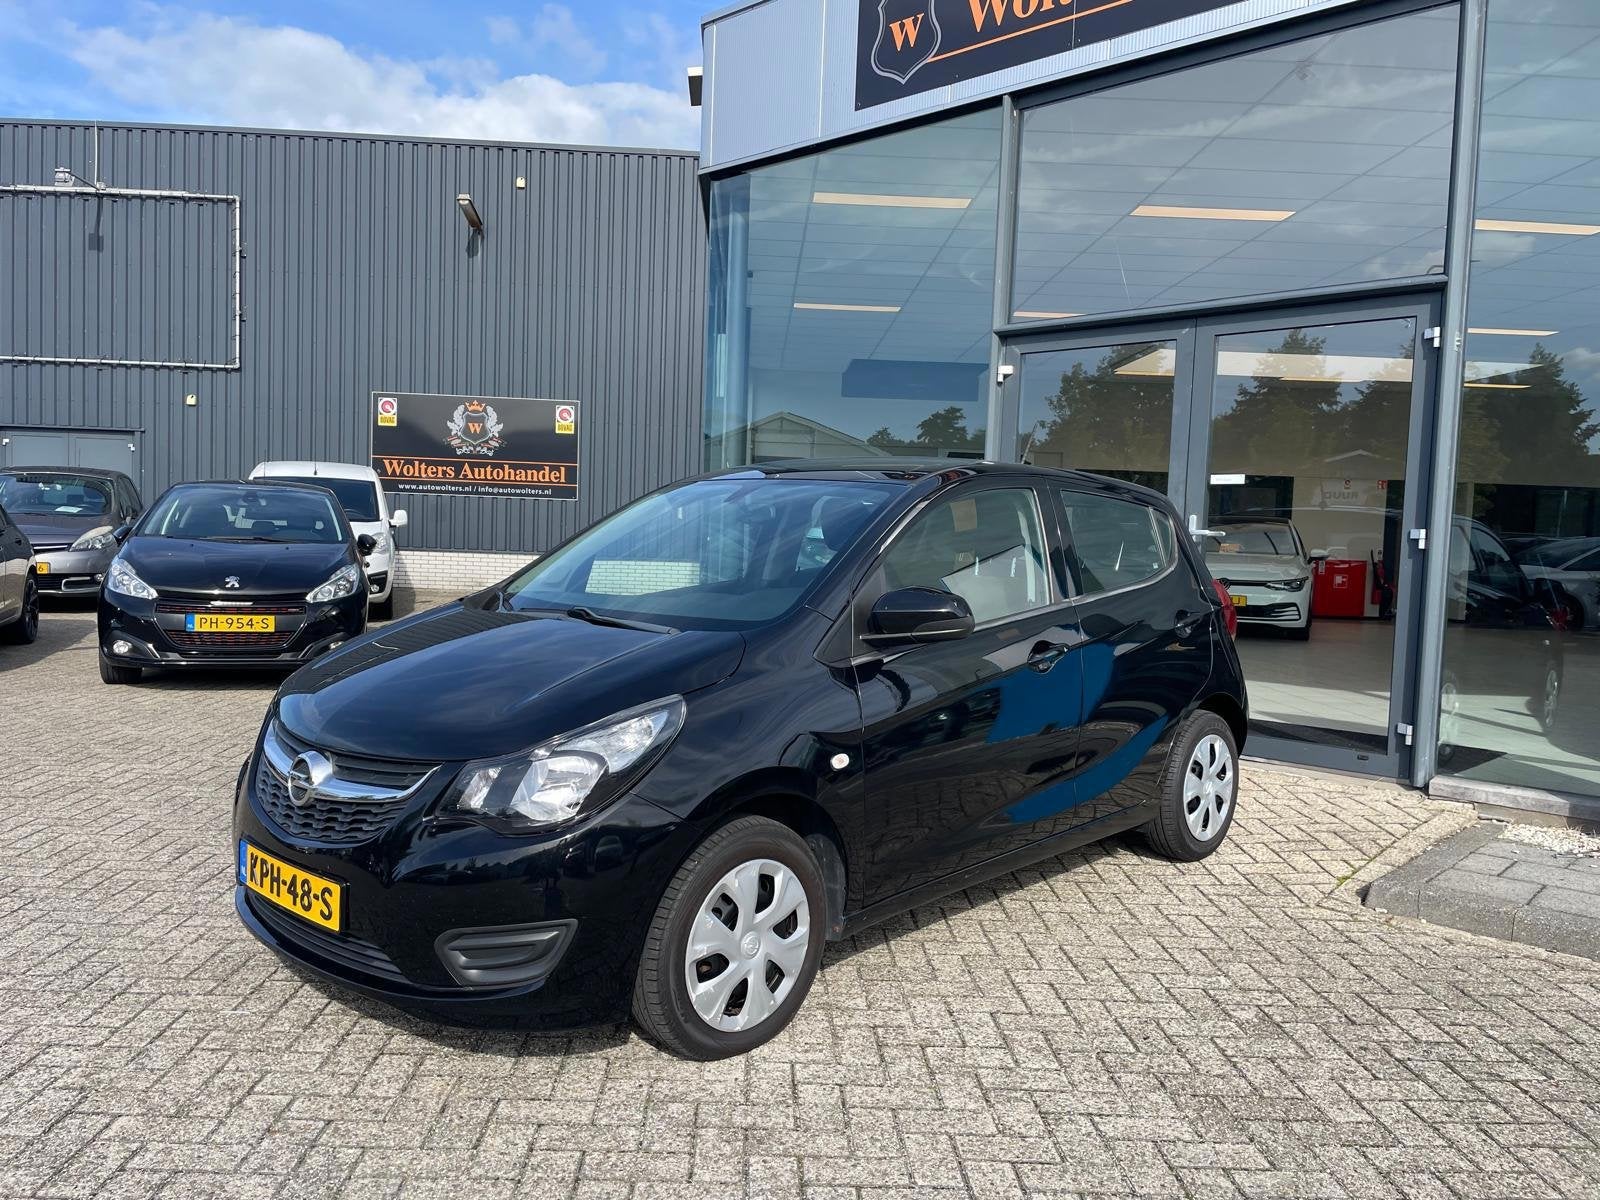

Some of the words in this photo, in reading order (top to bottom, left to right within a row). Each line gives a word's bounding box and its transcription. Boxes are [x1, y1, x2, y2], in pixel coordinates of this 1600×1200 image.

[888, 12, 925, 52] W
[467, 422, 483, 434] W
[382, 459, 455, 478] Wolters
[459, 462, 566, 482] Autohandel
[398, 483, 472, 492] www.autowolters.nl
[478, 486, 552, 495] info@autowolters.nl
[199, 617, 270, 629] PH-954-S
[249, 851, 333, 921] KPH-48-S
